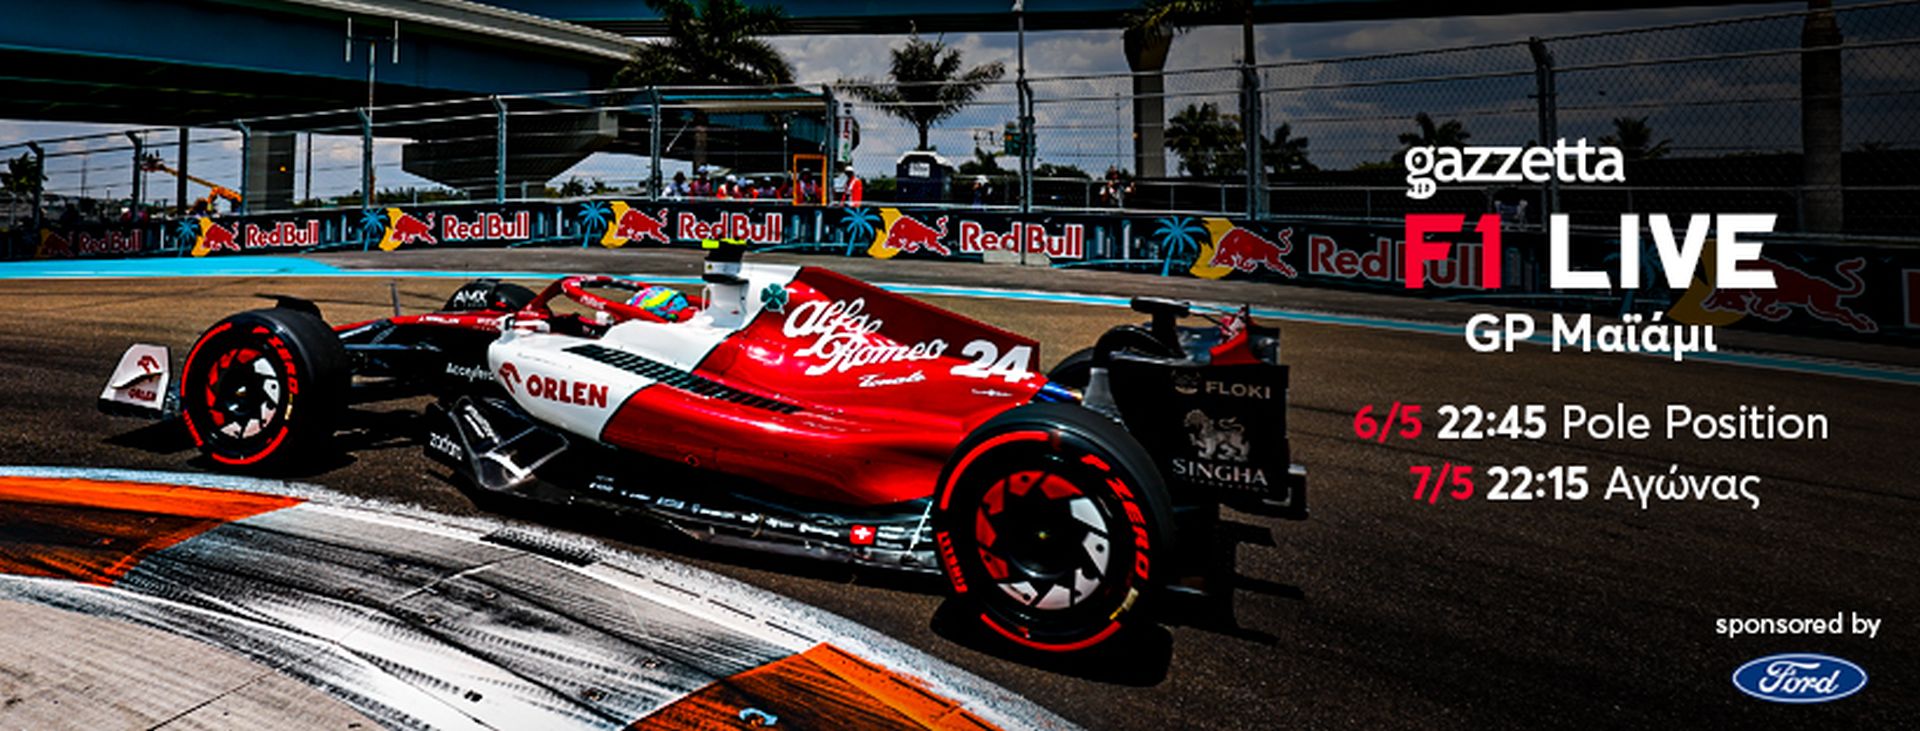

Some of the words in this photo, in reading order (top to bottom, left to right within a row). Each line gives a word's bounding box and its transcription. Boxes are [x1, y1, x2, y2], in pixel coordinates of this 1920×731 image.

[78, 232, 108, 253] Red
[108, 229, 142, 252] Bull
[245, 222, 281, 248] Red
[282, 219, 320, 246] Bull
[443, 214, 484, 240] Red
[486, 211, 531, 239] Bull
[678, 211, 729, 240] Red
[731, 212, 783, 243] Bull
[959, 221, 1022, 253] Red
[1024, 223, 1084, 258] Bull
[1308, 234, 1392, 281] Red
[782, 297, 883, 338] Alfa
[794, 333, 948, 376] Romeo
[950, 340, 1035, 383] 24
[526, 374, 609, 409] ORLEN
[1205, 380, 1271, 399] FLOKI
[1172, 458, 1268, 486] SINGHA
